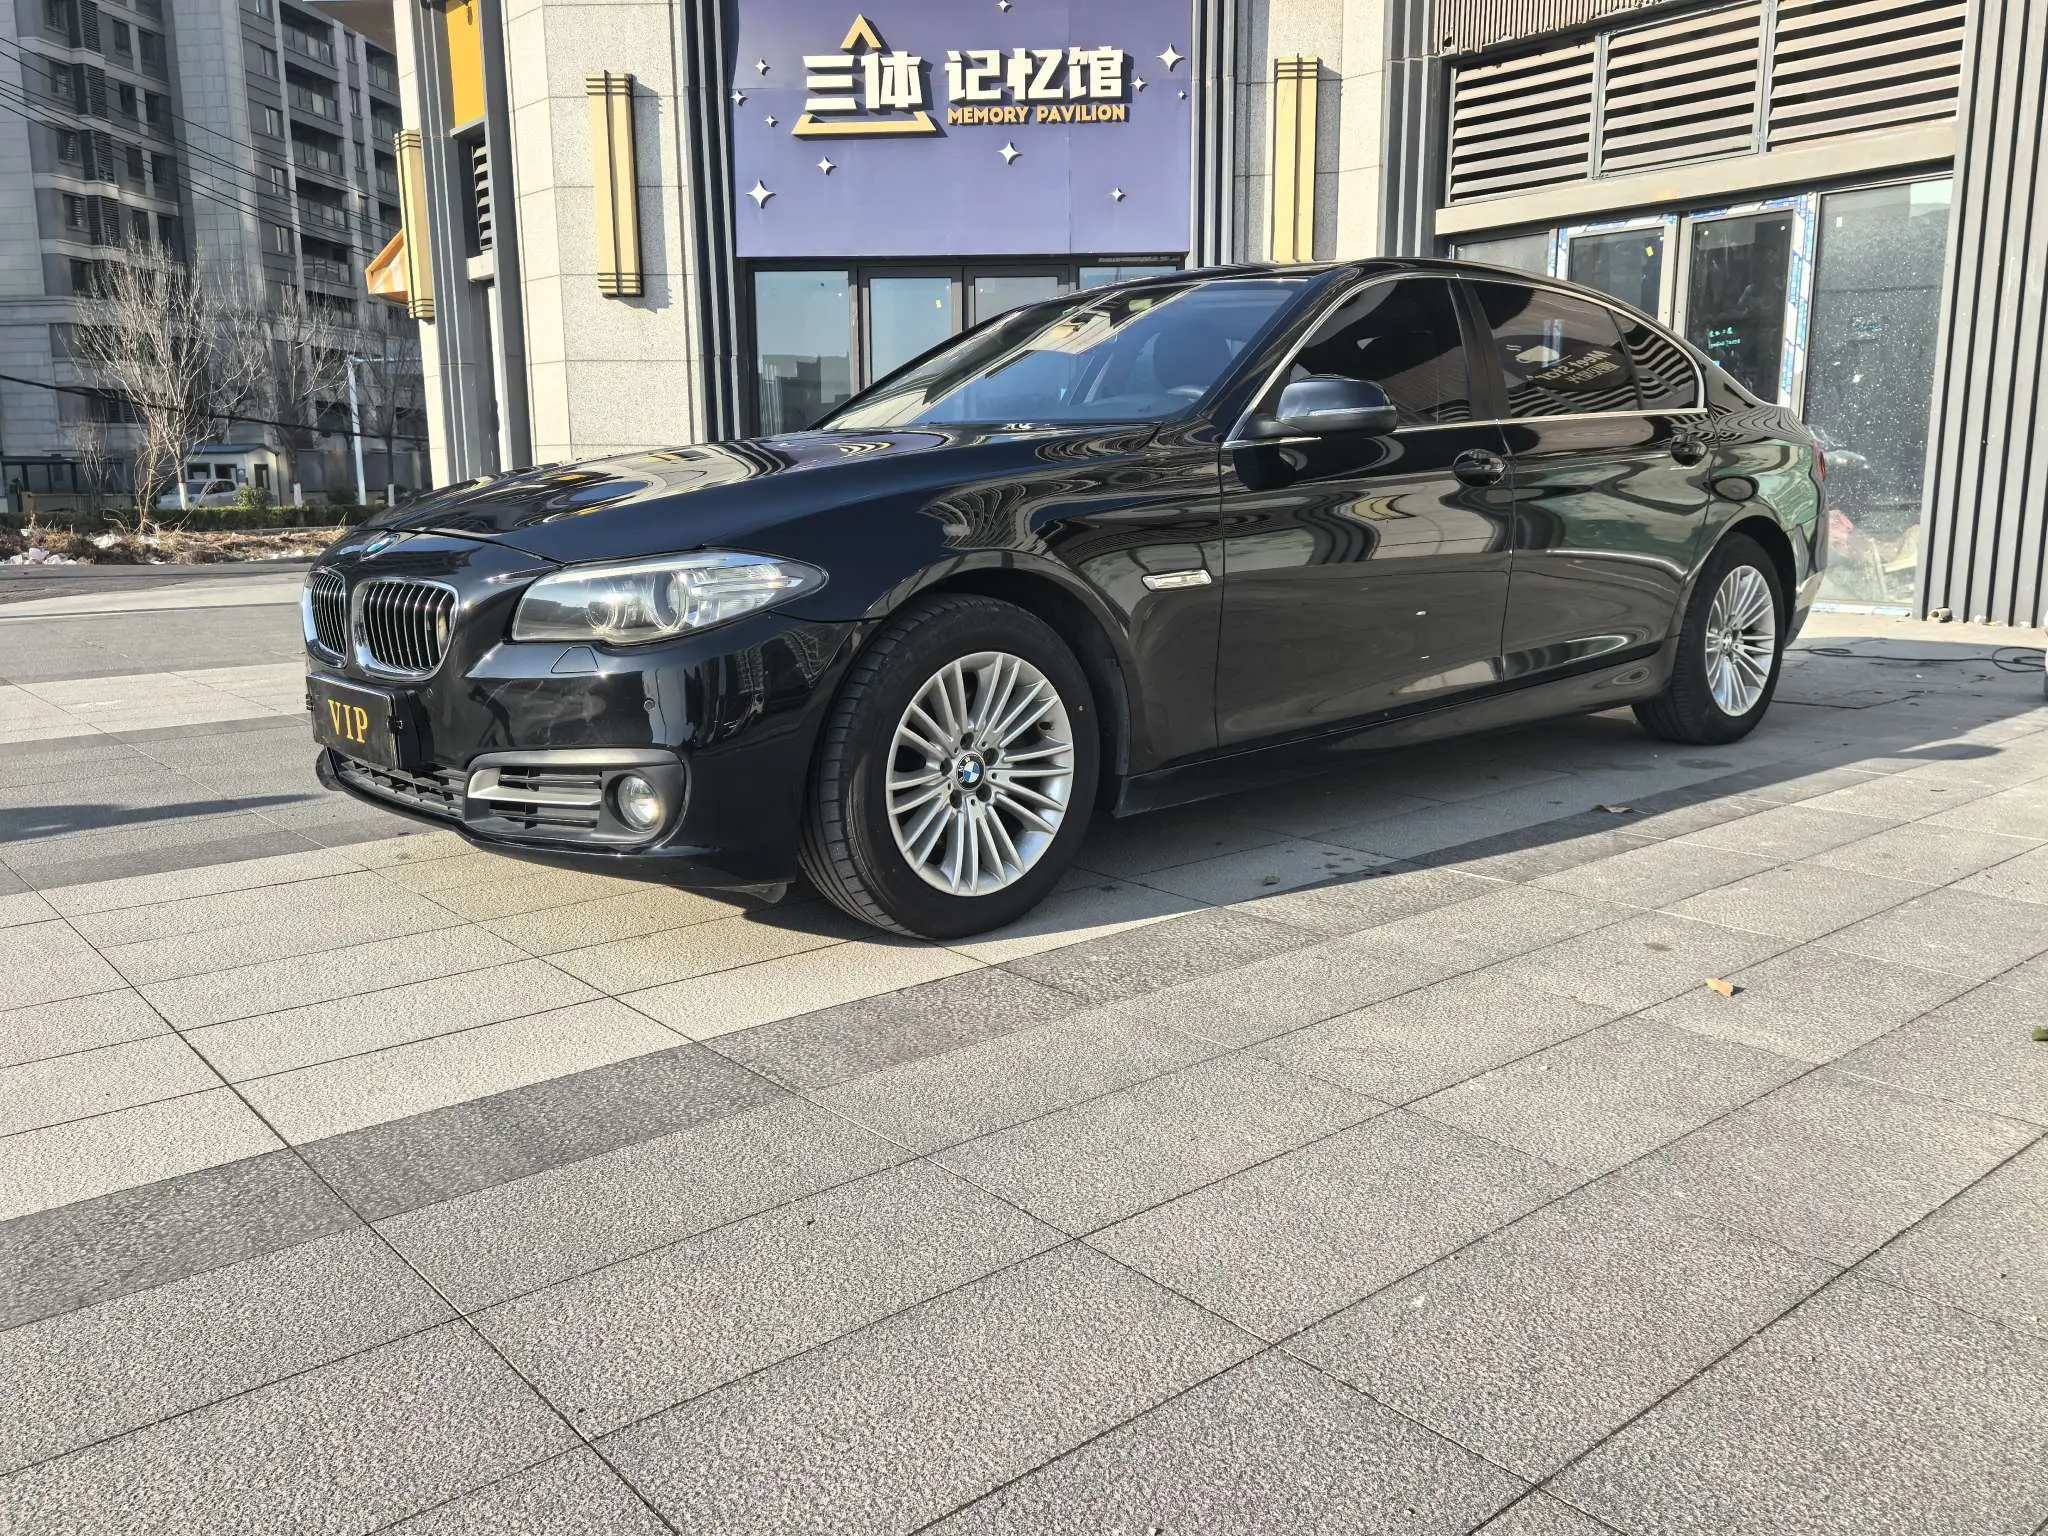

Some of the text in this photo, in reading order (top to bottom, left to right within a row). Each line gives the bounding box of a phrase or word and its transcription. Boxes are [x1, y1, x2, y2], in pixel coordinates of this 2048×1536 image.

[802, 46, 1124, 110] 三体 记忆馆
[947, 103, 1126, 126] MEMORY PAVILION
[327, 698, 369, 744] VIP
